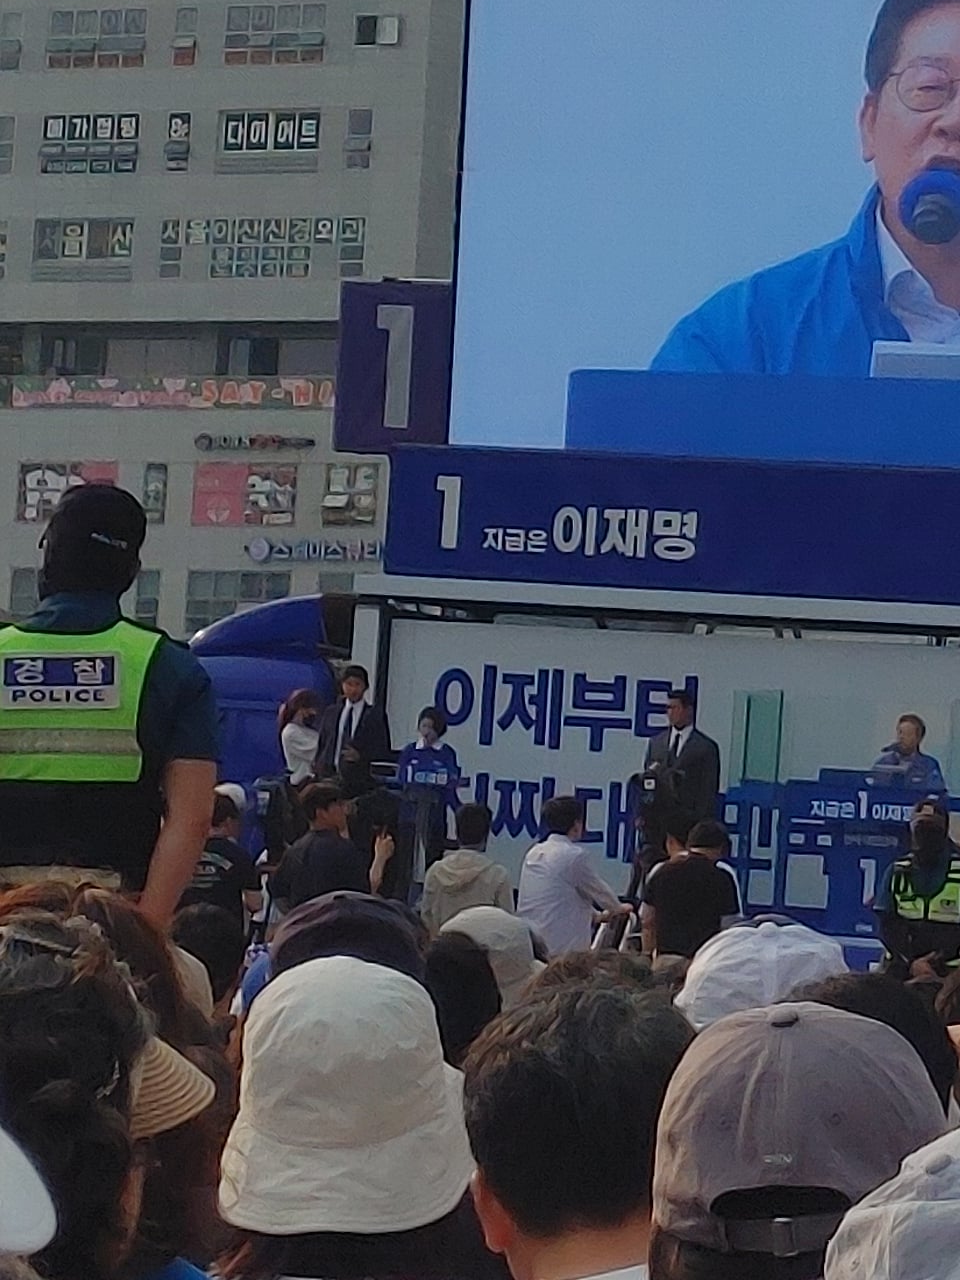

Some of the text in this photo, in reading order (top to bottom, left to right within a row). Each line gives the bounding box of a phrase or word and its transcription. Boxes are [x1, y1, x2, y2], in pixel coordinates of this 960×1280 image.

[376, 304, 415, 429] 1
[436, 475, 699, 562] 1 지금은 이재명
[12, 689, 105, 703] POLICE
